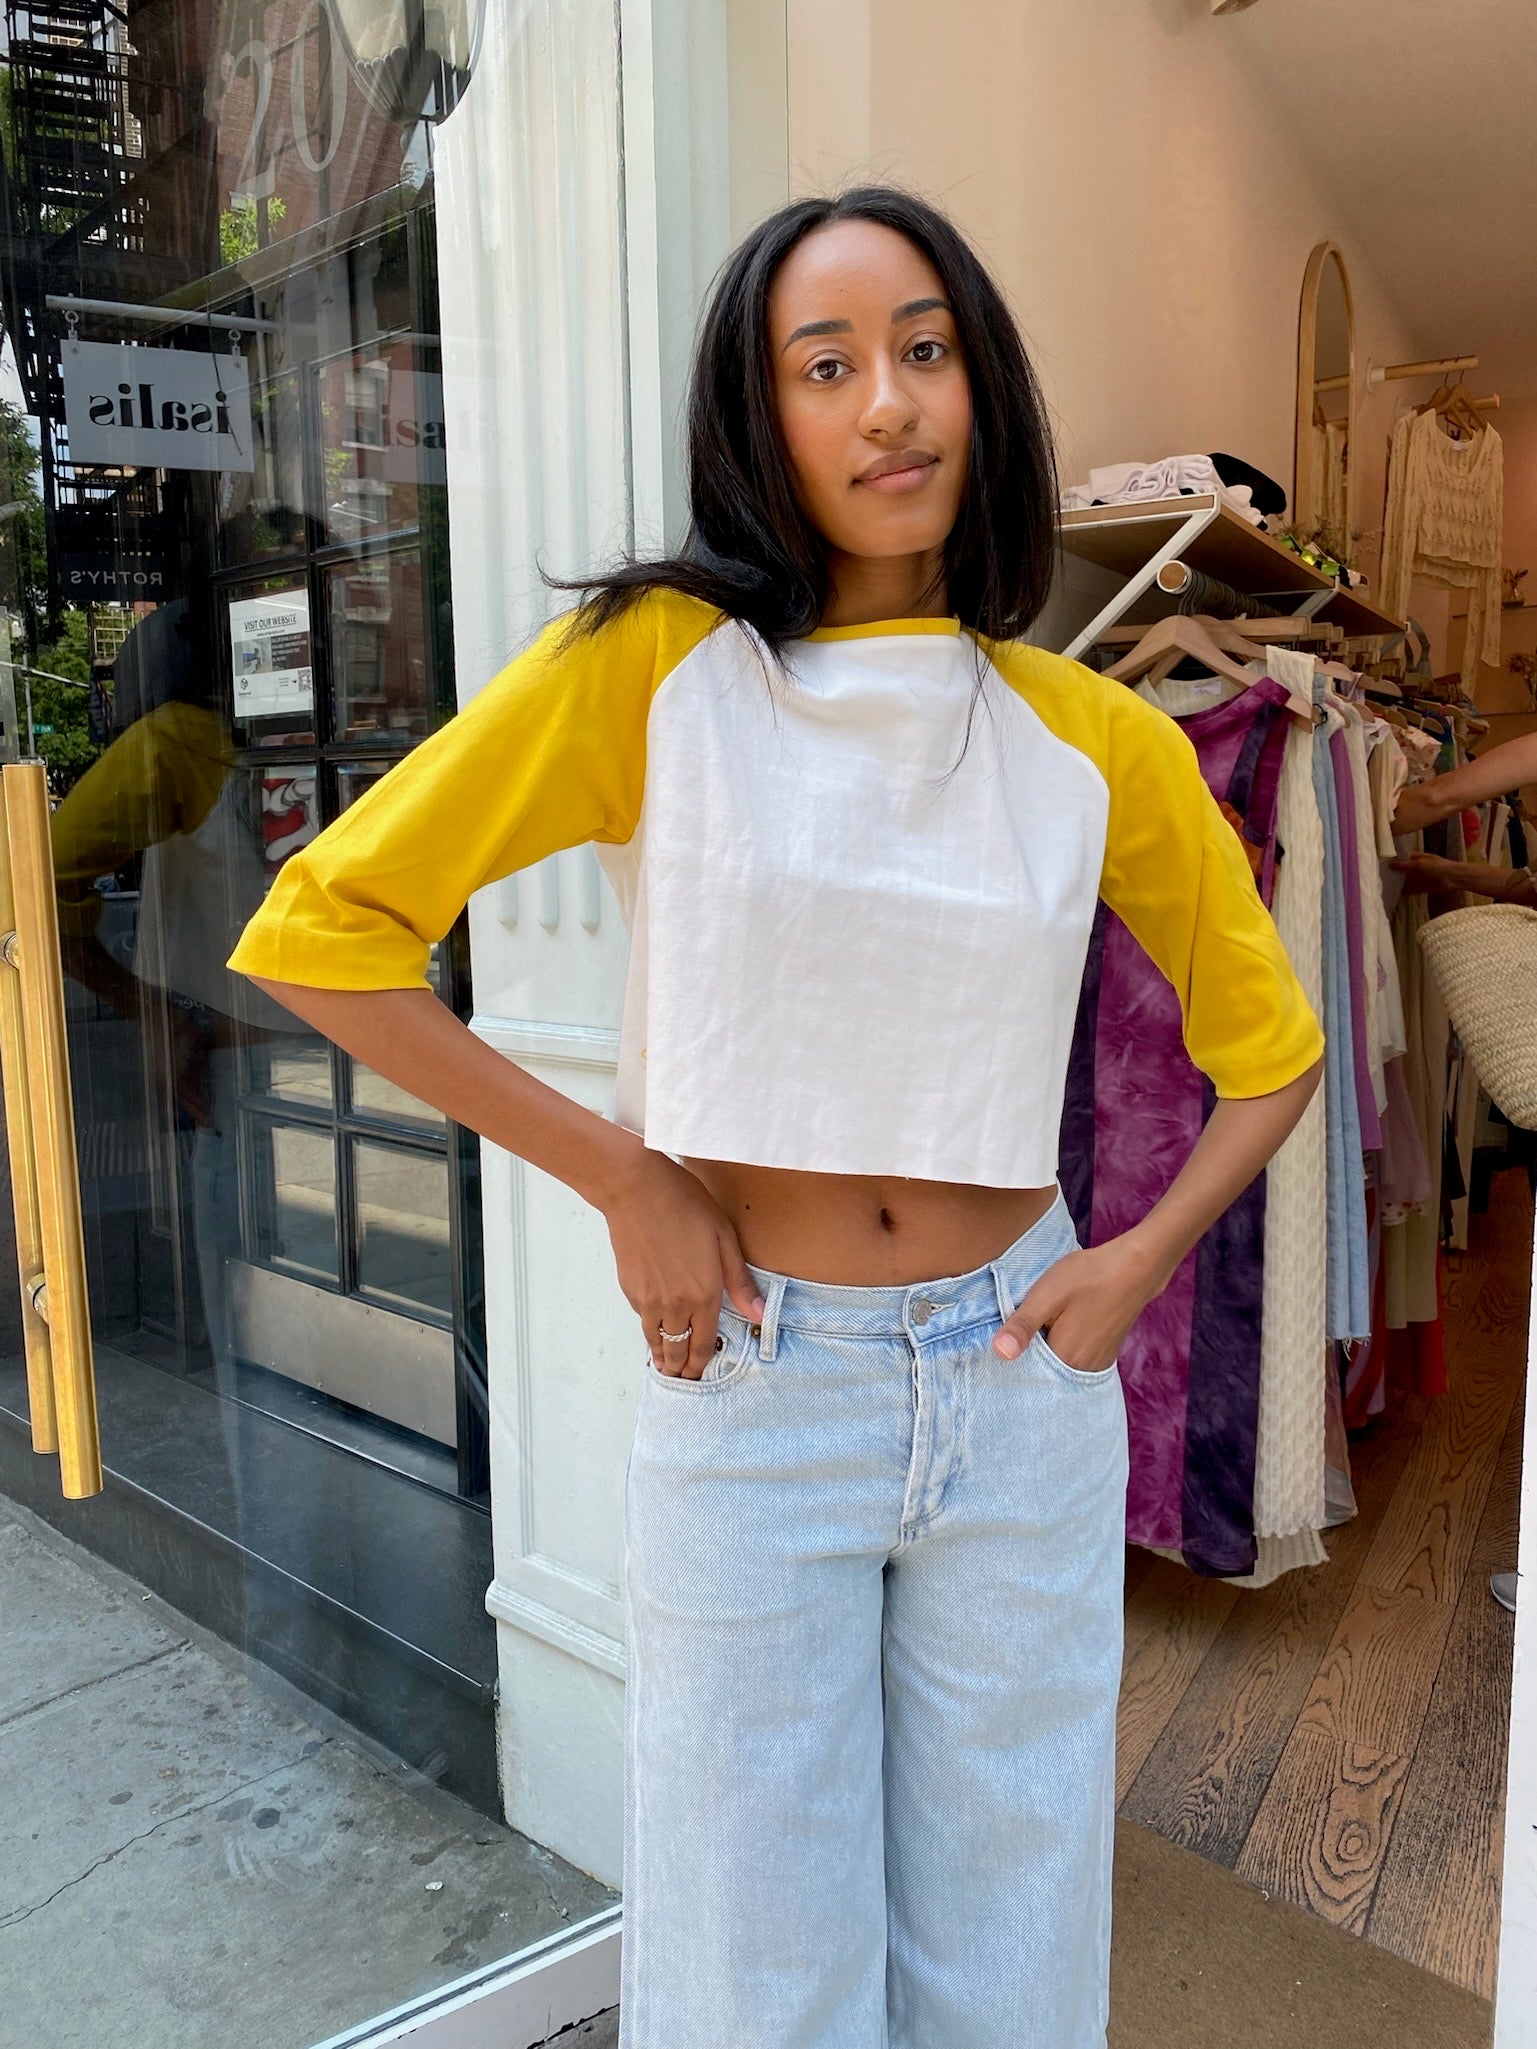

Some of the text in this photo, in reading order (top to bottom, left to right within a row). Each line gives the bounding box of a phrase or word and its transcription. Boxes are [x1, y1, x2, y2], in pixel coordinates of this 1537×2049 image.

[244, 613, 296, 631] VISIT OUR WEBSITE
